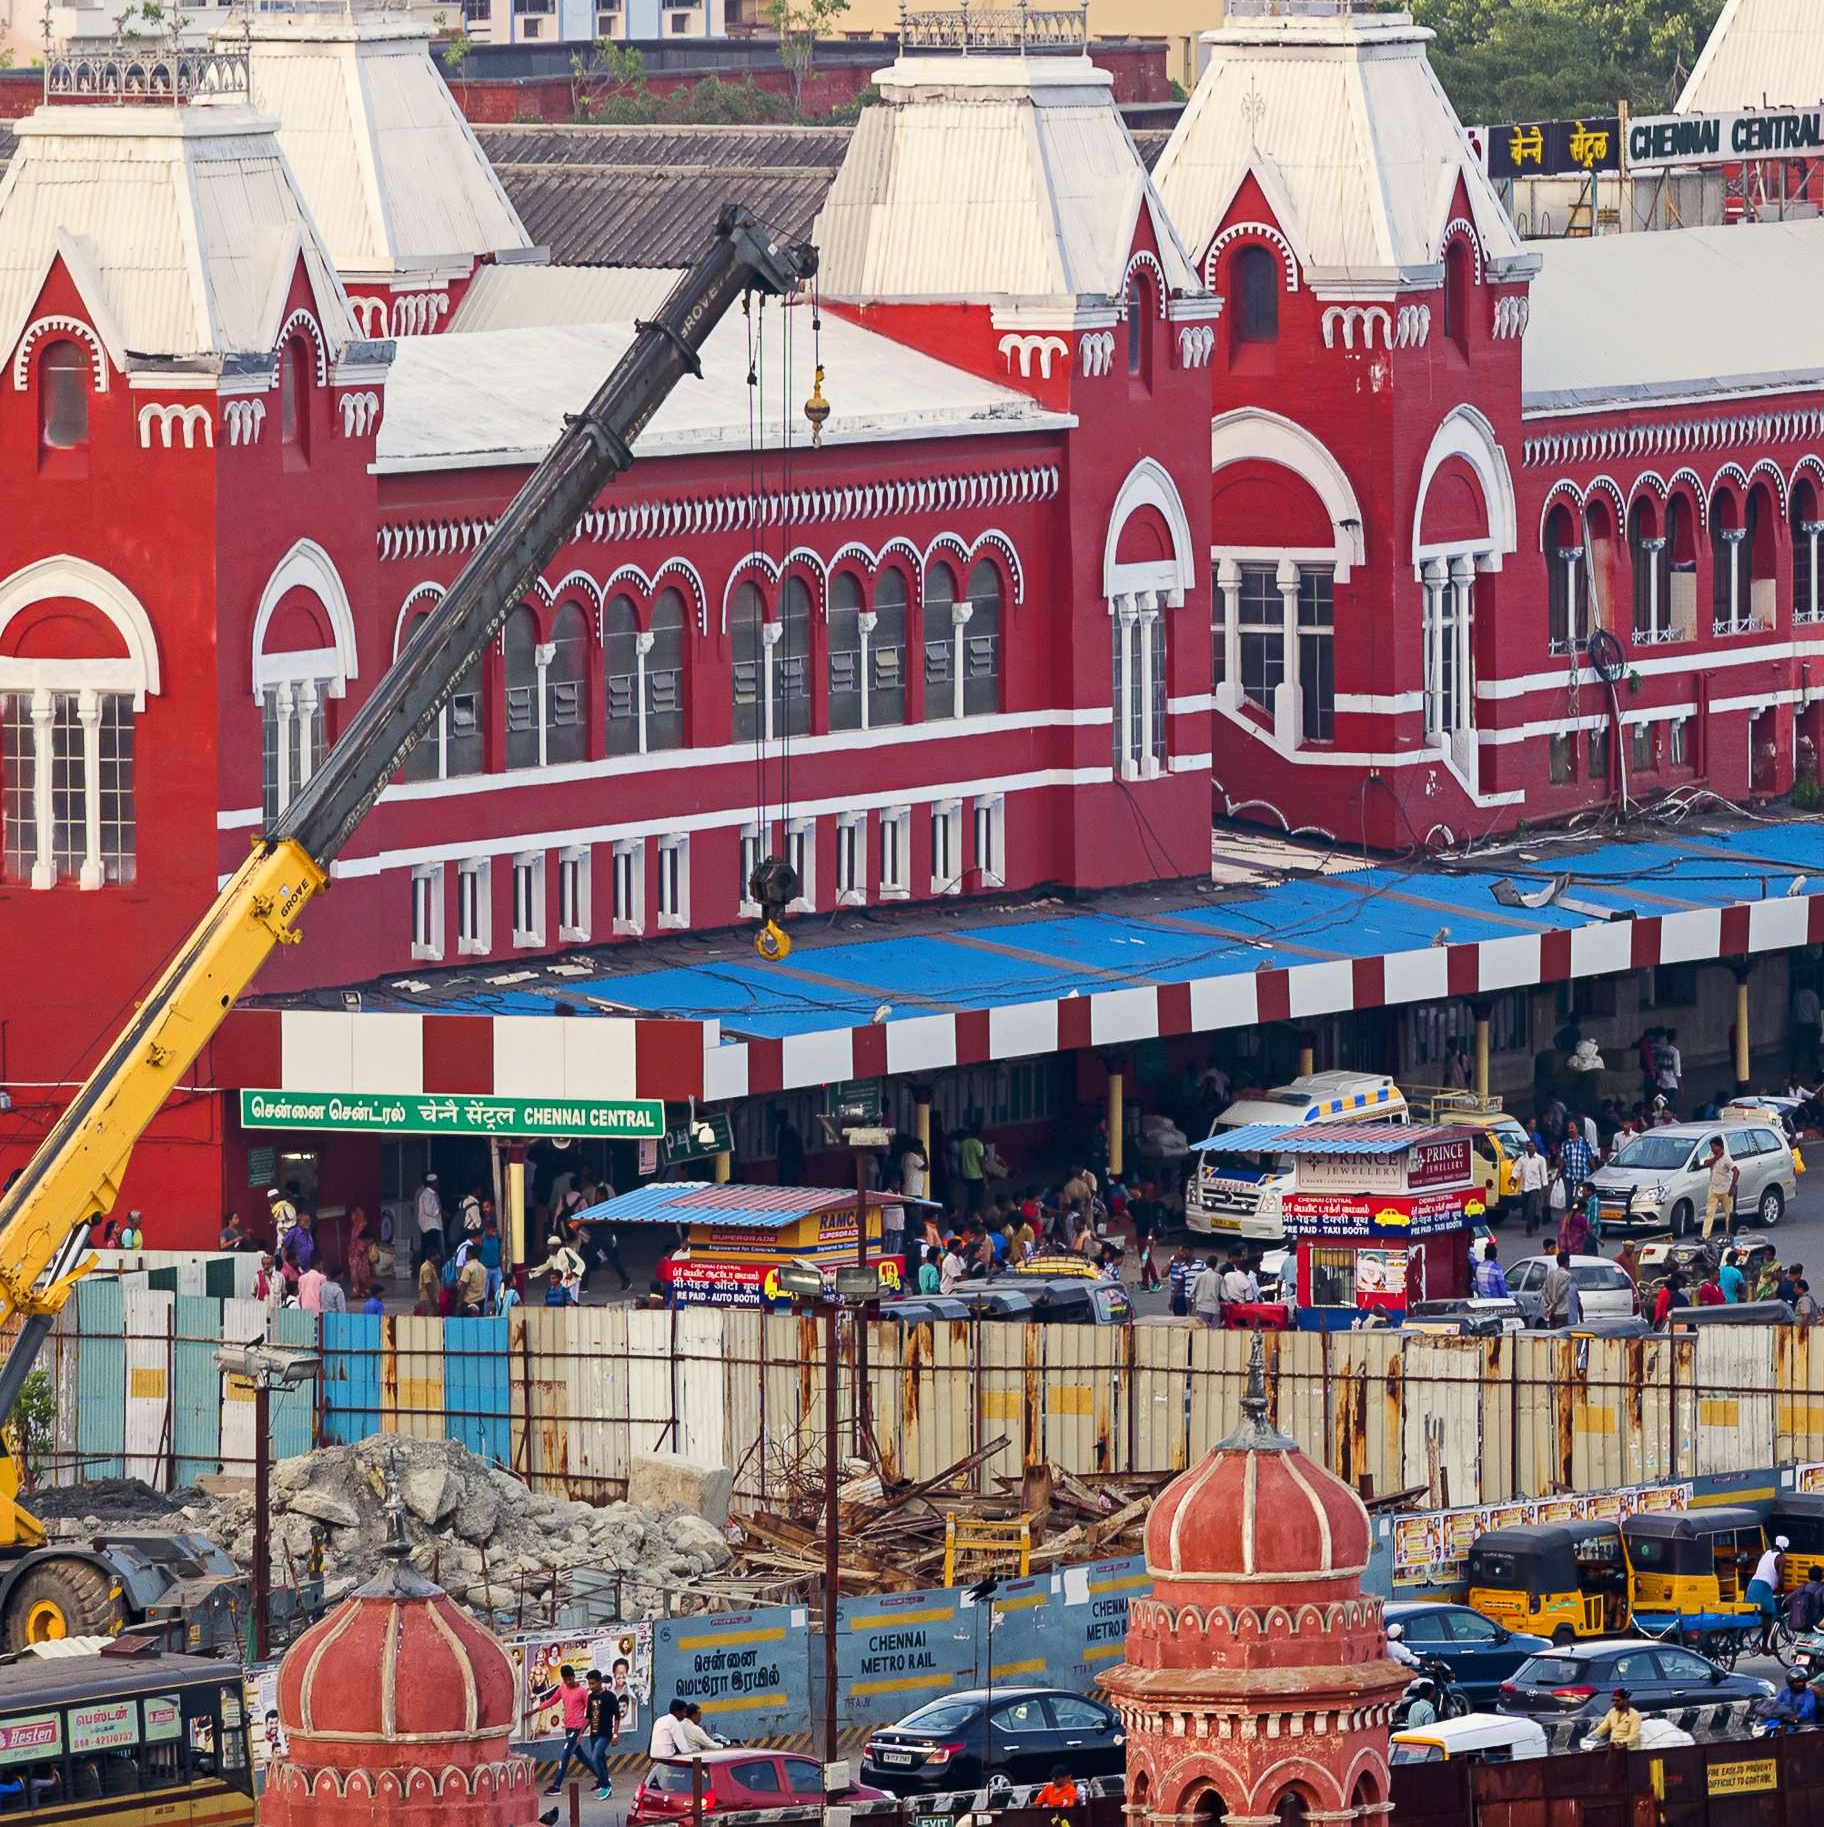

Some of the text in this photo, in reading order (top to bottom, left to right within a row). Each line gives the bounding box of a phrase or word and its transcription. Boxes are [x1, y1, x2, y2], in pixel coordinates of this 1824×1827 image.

[1630, 118, 1720, 160] CHENNAI
[281, 878, 309, 917] GROVE
[251, 1095, 406, 1124] சென்னை சென்ட்ரல்
[524, 1107, 655, 1128] CHENNAI CENTRAL
[1426, 1143, 1464, 1163] PRINCE
[1327, 1167, 1397, 1176] JEWELLERY
[1426, 1161, 1464, 1174] JEWELLERY
[820, 1211, 858, 1229] RAMC
[711, 1234, 776, 1242] SUPERGRADE
[1282, 1225, 1369, 1235] PRE PAID TAXI BOOTH
[689, 1292, 706, 1301] PAID
[711, 1293, 732, 1302] AUTO
[734, 1294, 760, 1304] BOOTH
[1092, 1597, 1129, 1617] CHENNA
[869, 1631, 927, 1653] CHENNAI
[1087, 1623, 1119, 1642] METRO
[694, 1649, 758, 1673] சென்னை
[861, 1651, 937, 1674] METRO RAIL
[676, 1664, 781, 1697] மெட்ரோ இரயில்
[11, 1726, 54, 1744] Besten
[1722, 1767, 1736, 1777] EASY
[1747, 1764, 1774, 1775] PREVENT
[1746, 1774, 1772, 1785] CONTROL
